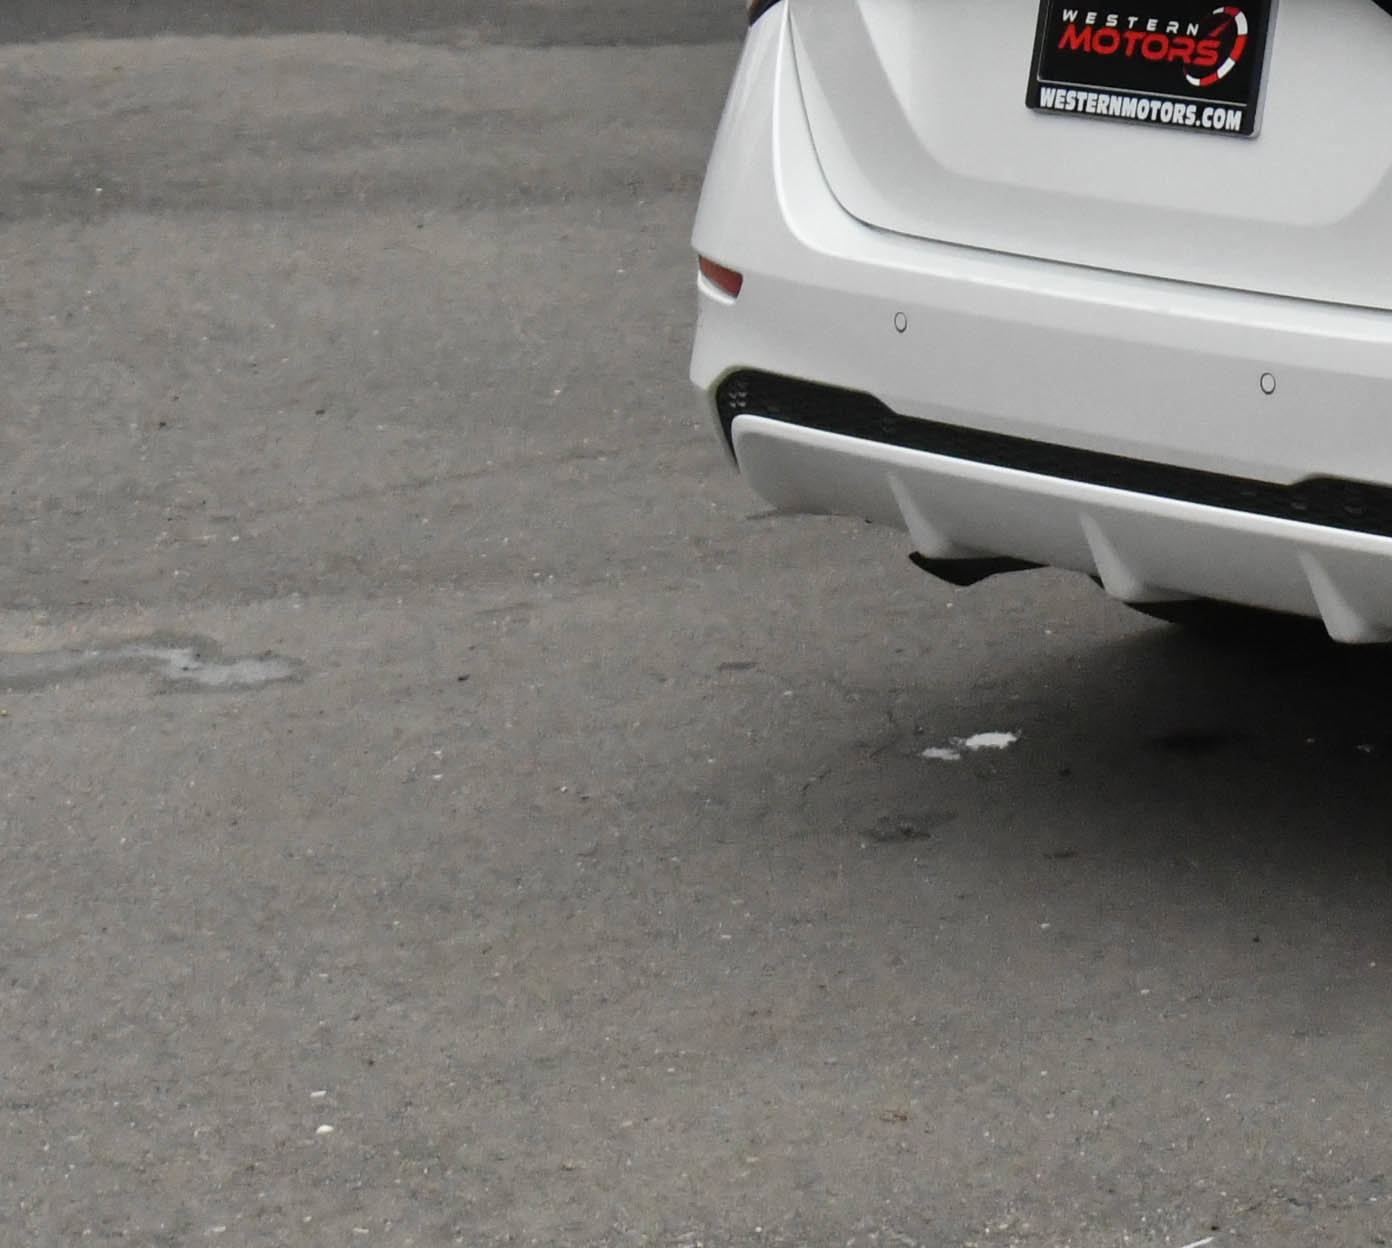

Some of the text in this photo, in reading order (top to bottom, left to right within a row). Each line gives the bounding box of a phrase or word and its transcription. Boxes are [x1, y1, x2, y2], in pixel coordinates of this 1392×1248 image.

[1062, 9, 1200, 36] WESTERN
[1058, 24, 1222, 65] MOTORS
[1039, 86, 1243, 132] WESTERNMOTORS.COM
